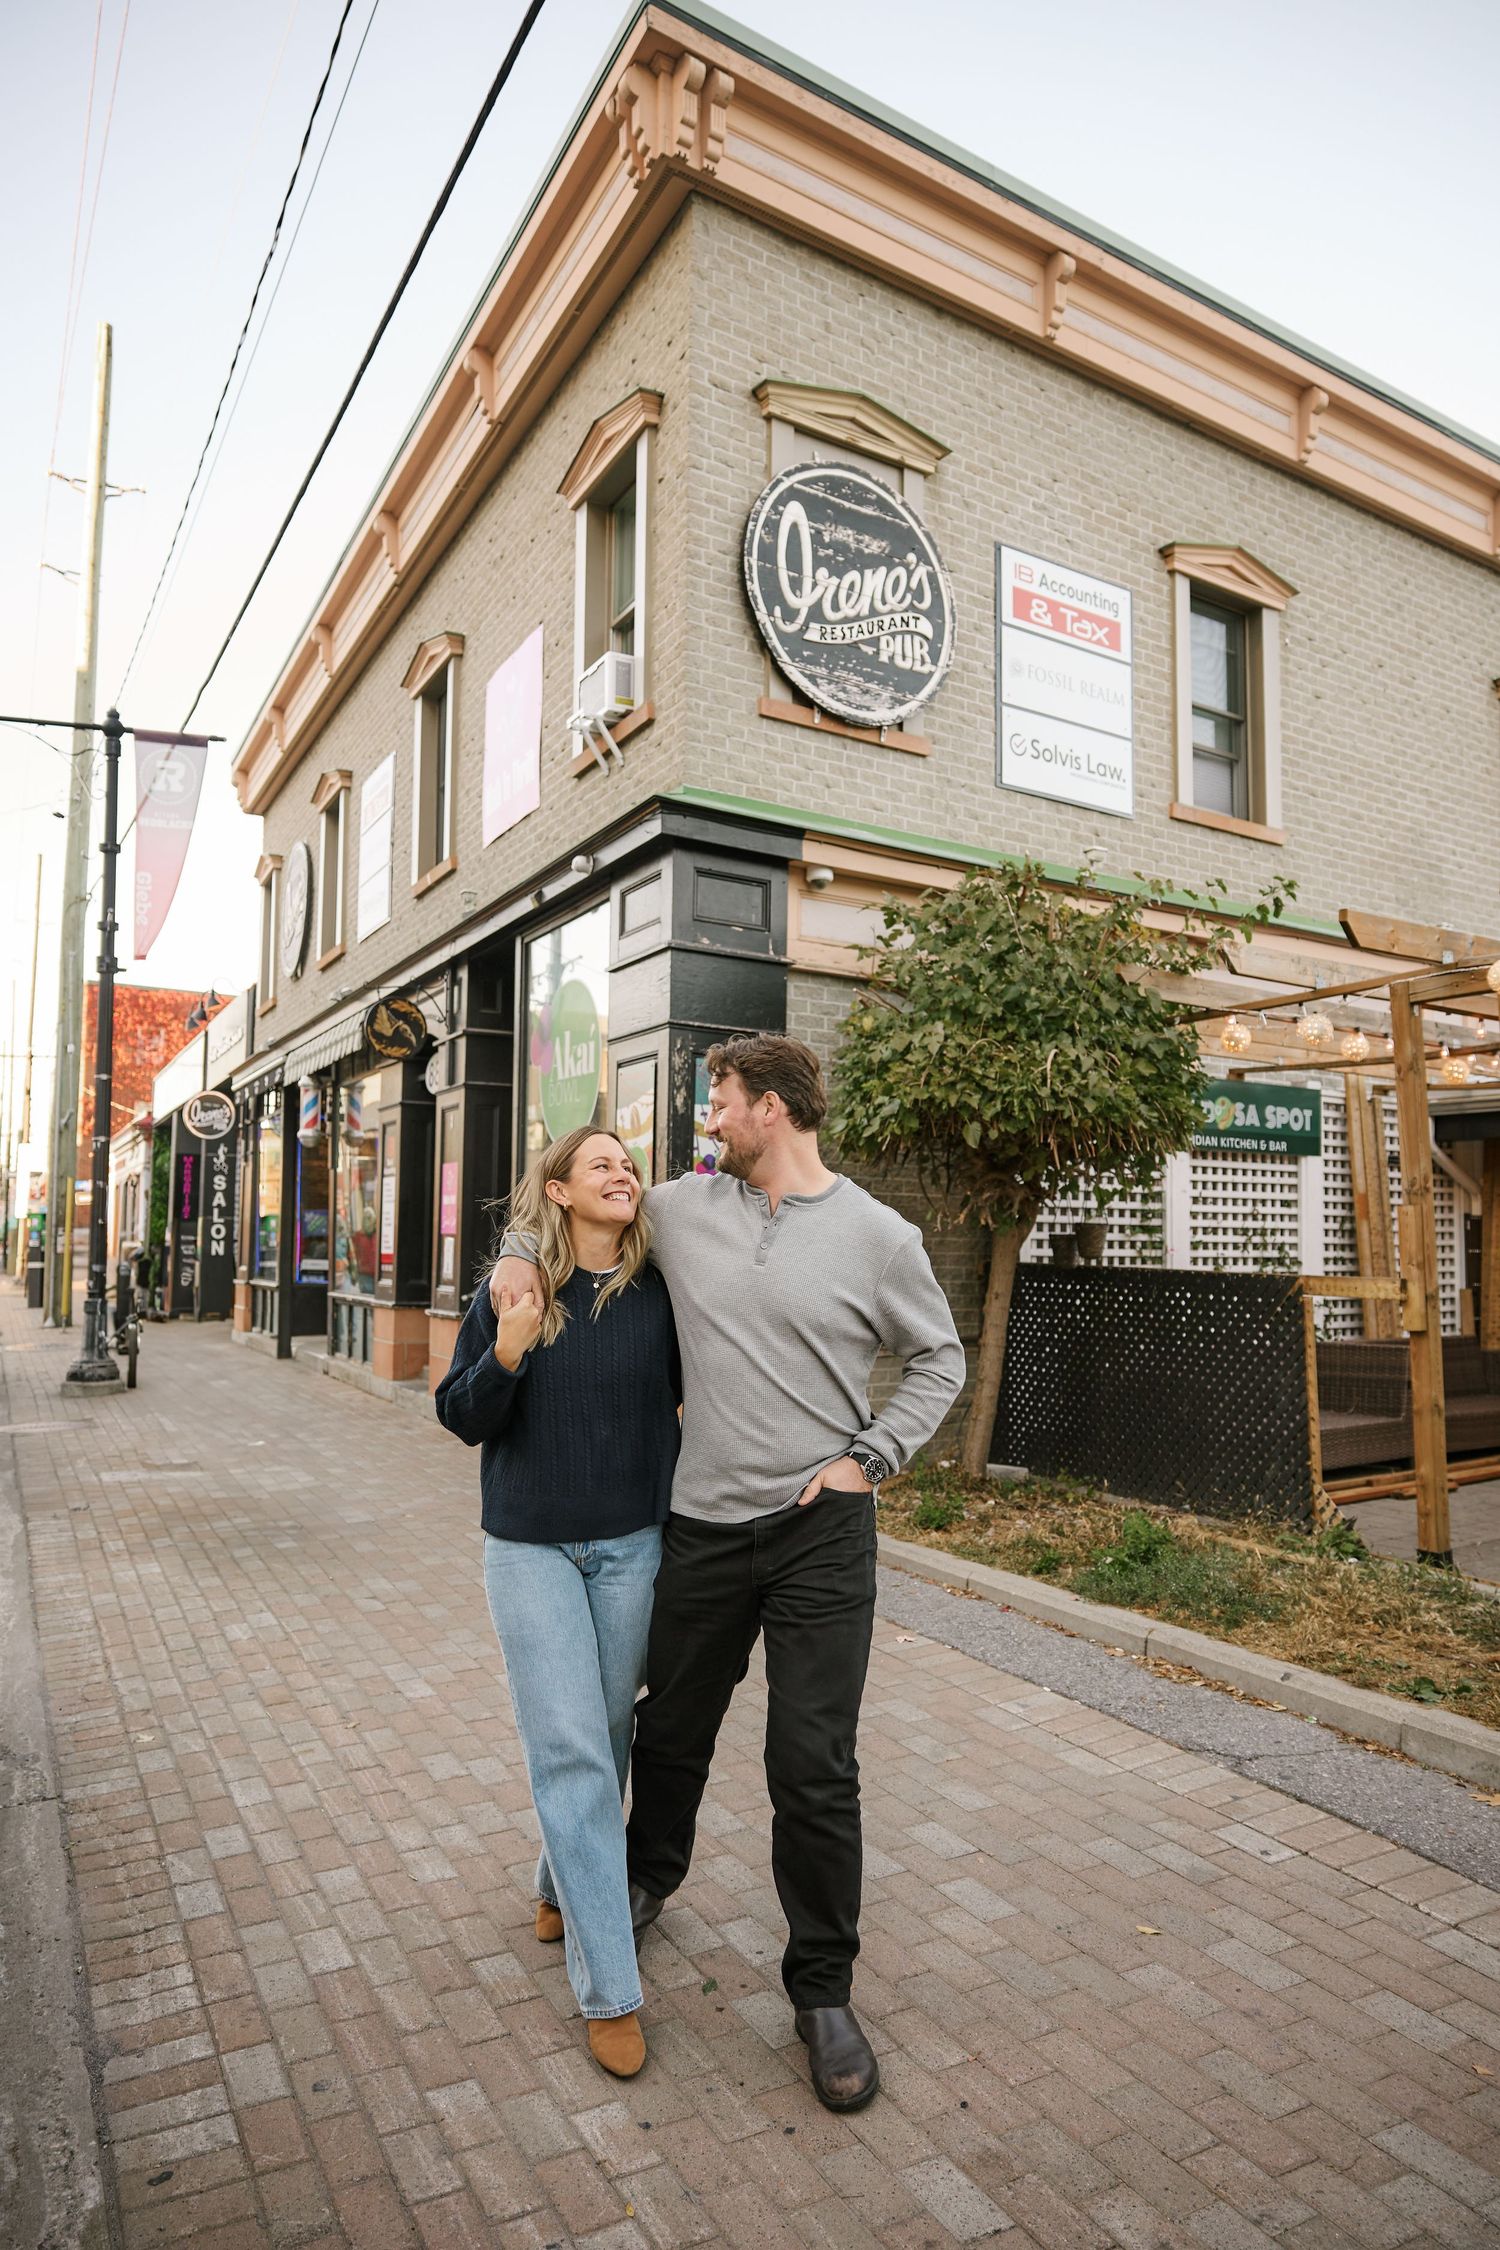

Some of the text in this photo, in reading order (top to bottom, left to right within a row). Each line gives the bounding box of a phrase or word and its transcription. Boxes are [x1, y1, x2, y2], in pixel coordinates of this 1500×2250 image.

[773, 500, 932, 633] Irene's
[1013, 563, 1119, 618] IB Accounting
[819, 615, 921, 642] RESTAURANT
[1029, 598, 1110, 646] & Tax
[877, 634, 937, 674] PUB
[1027, 663, 1126, 707] FOSSIL REALM
[1030, 739, 1081, 771] Solvis
[1087, 753, 1127, 784] Law.
[136, 871, 152, 926] Glebe
[548, 1081, 581, 1106] BOWL
[1264, 1104, 1313, 1132] SPOT
[1220, 1137, 1258, 1150] KITCHEN
[1260, 1141, 1268, 1151] &
[1269, 1141, 1288, 1152] BAR
[210, 1174, 227, 1257] SALON
